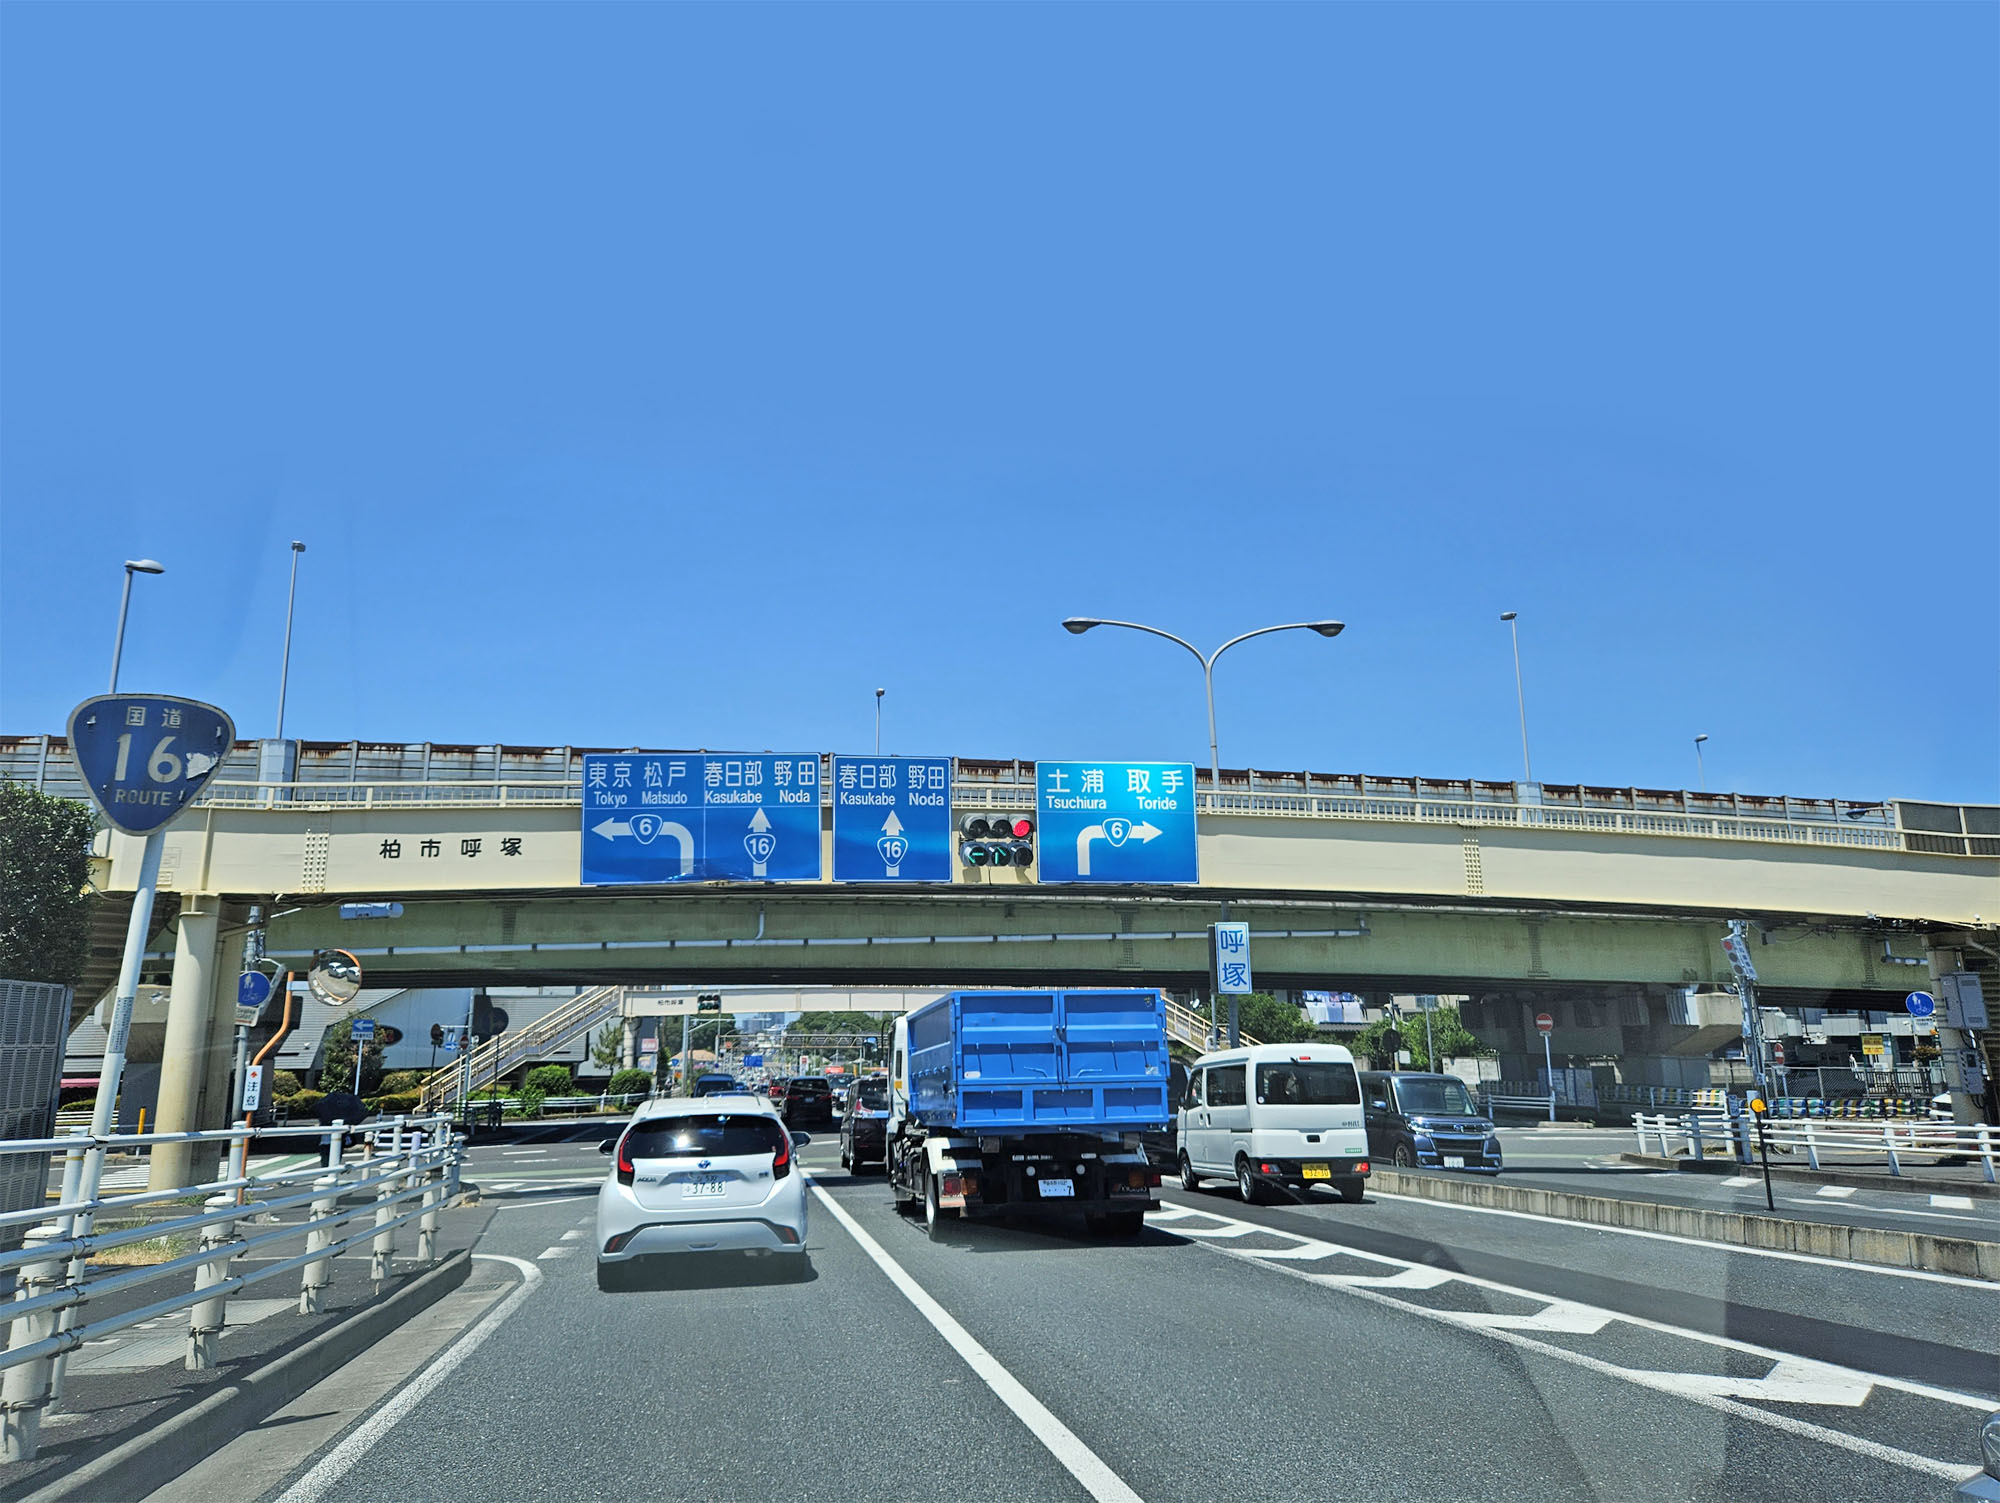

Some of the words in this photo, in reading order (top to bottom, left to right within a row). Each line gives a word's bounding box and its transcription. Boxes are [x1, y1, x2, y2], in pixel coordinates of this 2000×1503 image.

[126, 706, 182, 729] 国道
[114, 733, 182, 783] 16
[588, 761, 632, 788] 東京
[644, 761, 686, 788] 松戸
[704, 760, 763, 788] 春日部
[774, 760, 815, 787] 野田
[839, 763, 897, 789] 春日部
[908, 765, 945, 790] 野田
[1046, 768, 1105, 793] 土浦
[1126, 768, 1185, 794] 取手
[114, 788, 173, 806] ROUTE
[594, 791, 628, 808] Tokyo
[642, 791, 688, 805] Matsudo
[704, 790, 763, 804] Kasukabe
[779, 789, 810, 803] Noda
[840, 792, 896, 806] Kasukabe
[909, 793, 944, 806] Noda
[1045, 795, 1107, 809] Tsuchiura
[1136, 796, 1177, 810] Toride
[639, 818, 652, 835] 6
[1111, 822, 1123, 838] 6
[379, 838, 523, 859] 柏市呼塚
[749, 837, 770, 855] 16
[883, 841, 902, 858] 16
[1220, 929, 1248, 987] 呼塚
[692, 1182, 724, 1195] 37-88
